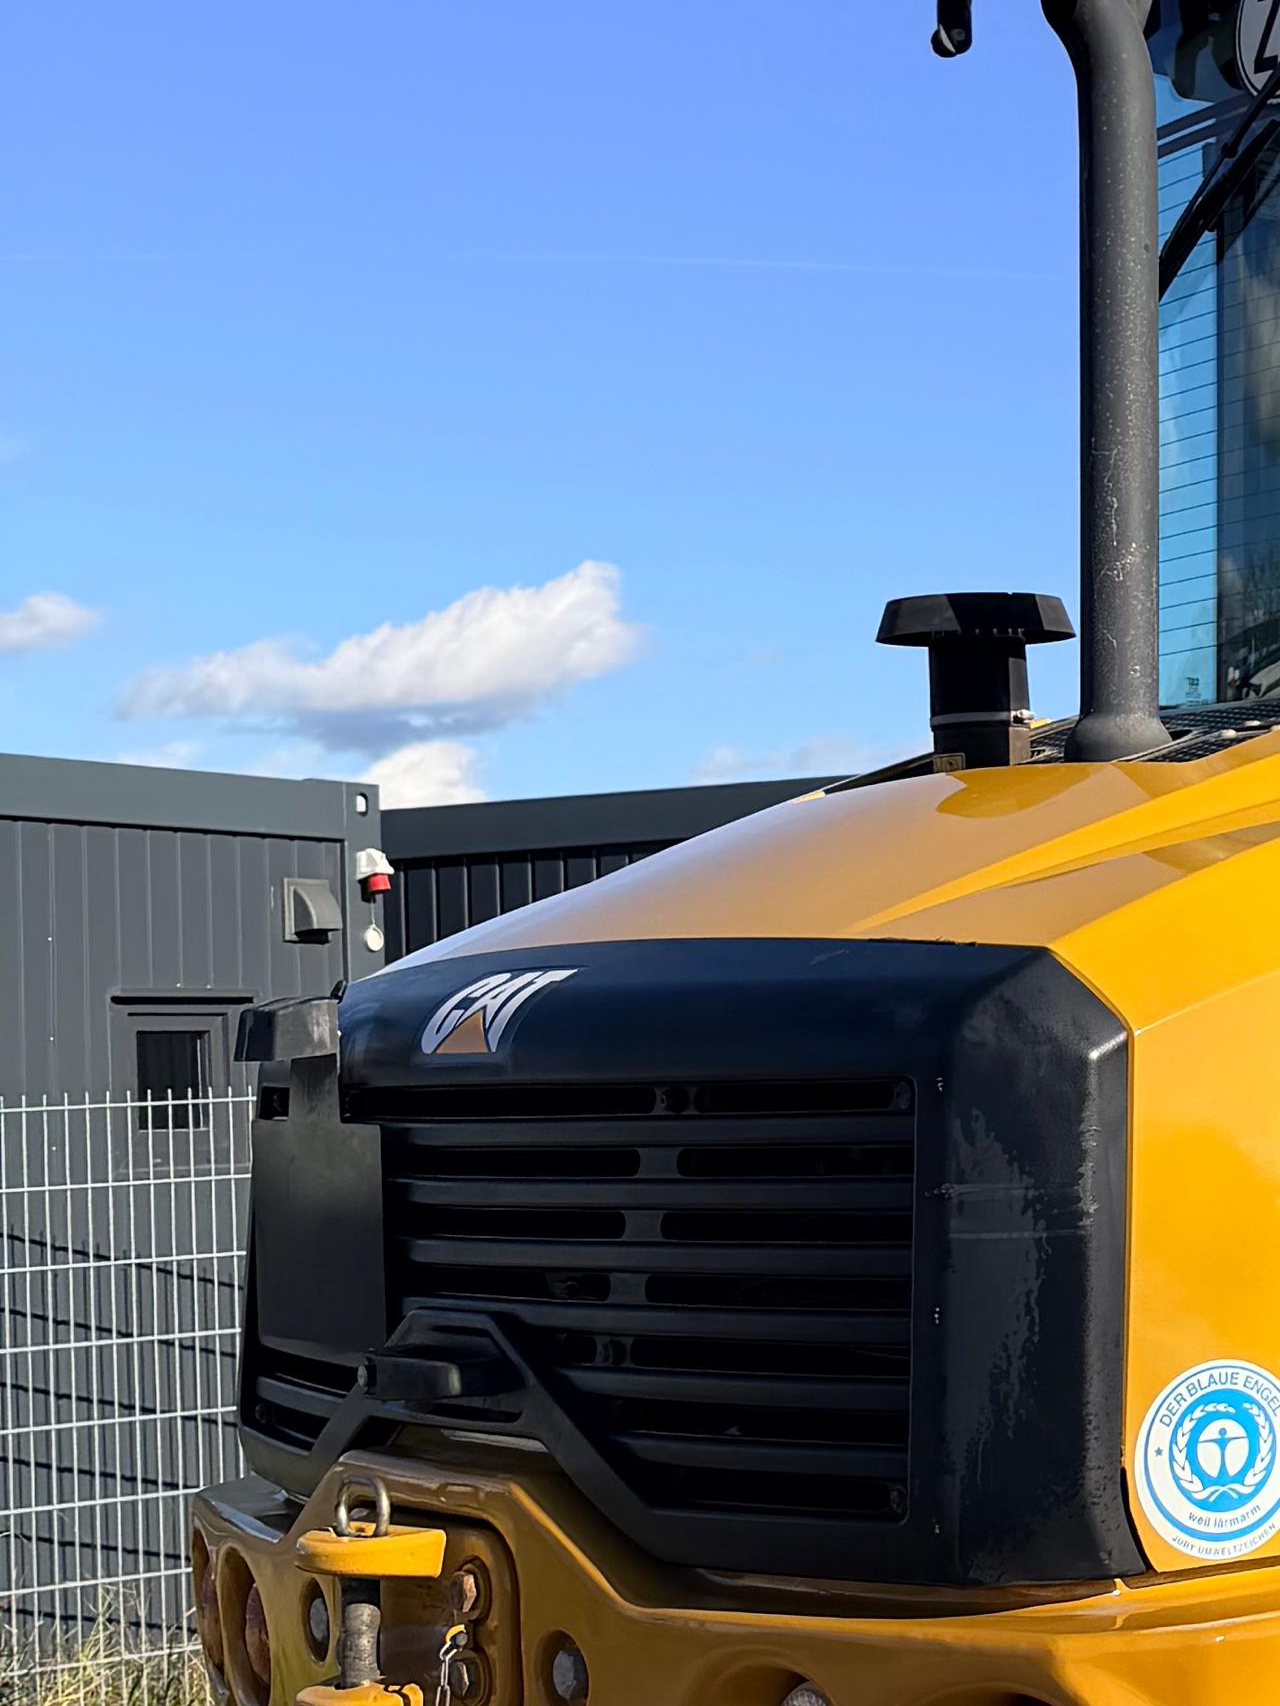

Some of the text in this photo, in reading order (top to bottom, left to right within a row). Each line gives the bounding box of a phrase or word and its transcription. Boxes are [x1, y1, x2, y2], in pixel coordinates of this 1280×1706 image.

[421, 969, 578, 1054] CAT
[1160, 1392, 1188, 1428] DER
[1187, 1372, 1240, 1397] BLAUE
[1188, 1511, 1212, 1528] weil
